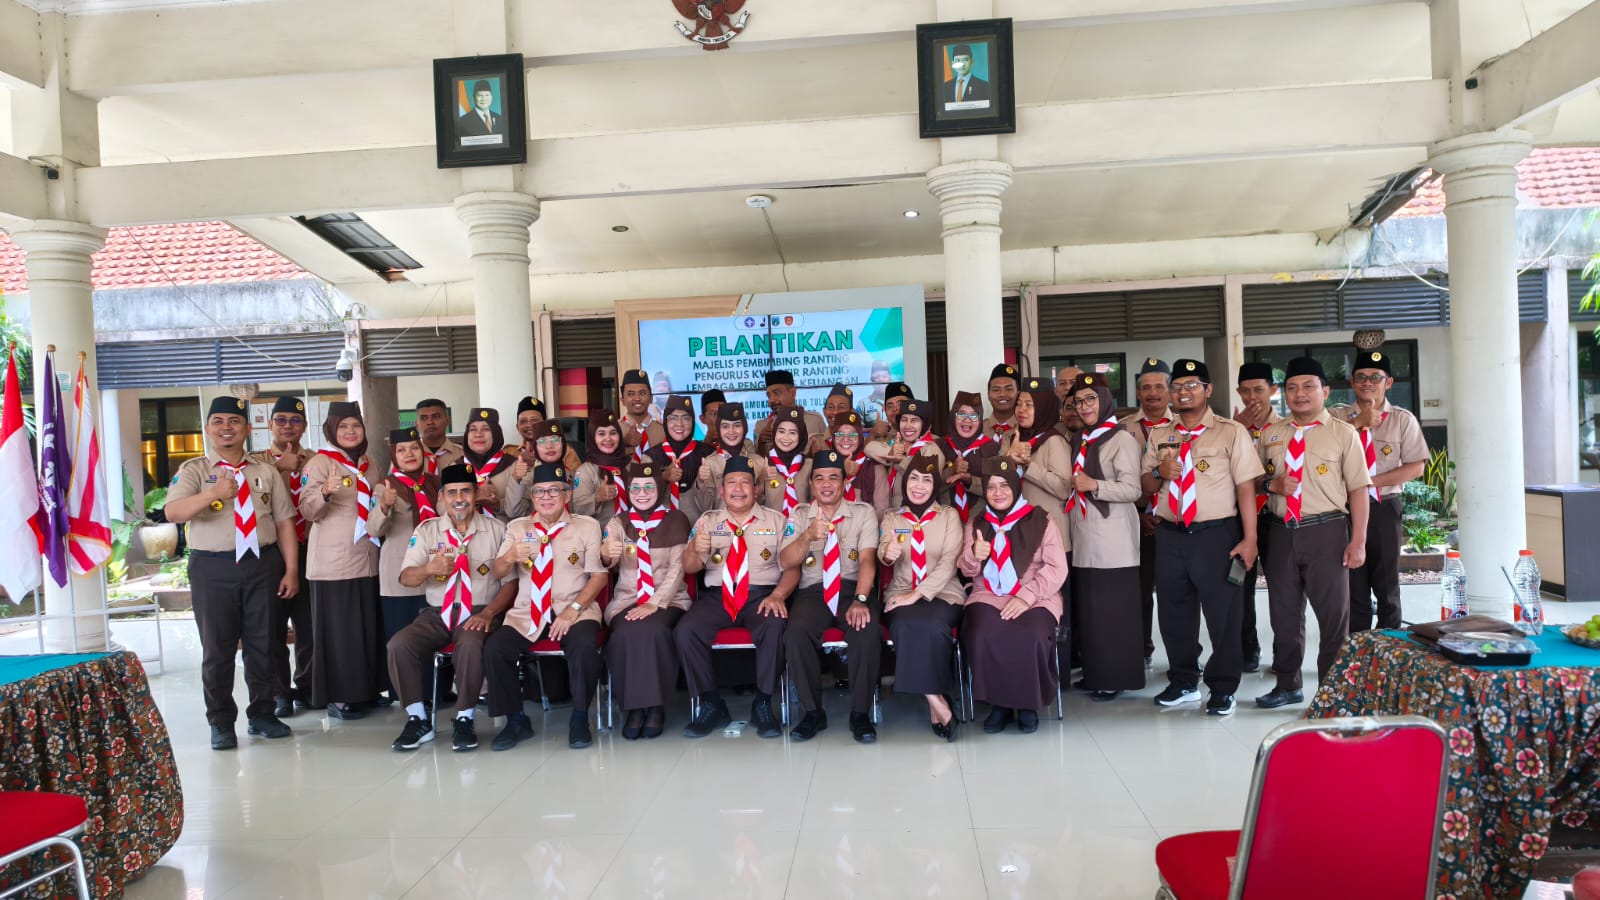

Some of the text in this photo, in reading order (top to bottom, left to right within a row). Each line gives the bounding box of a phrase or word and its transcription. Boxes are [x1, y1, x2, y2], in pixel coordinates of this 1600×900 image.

[688, 329, 854, 358] PELANTIKAN
[693, 353, 850, 370] MAJELIS PEMBIMBING RANTING
[695, 370, 749, 381] PENGURUS
[802, 366, 849, 377] RANTING
